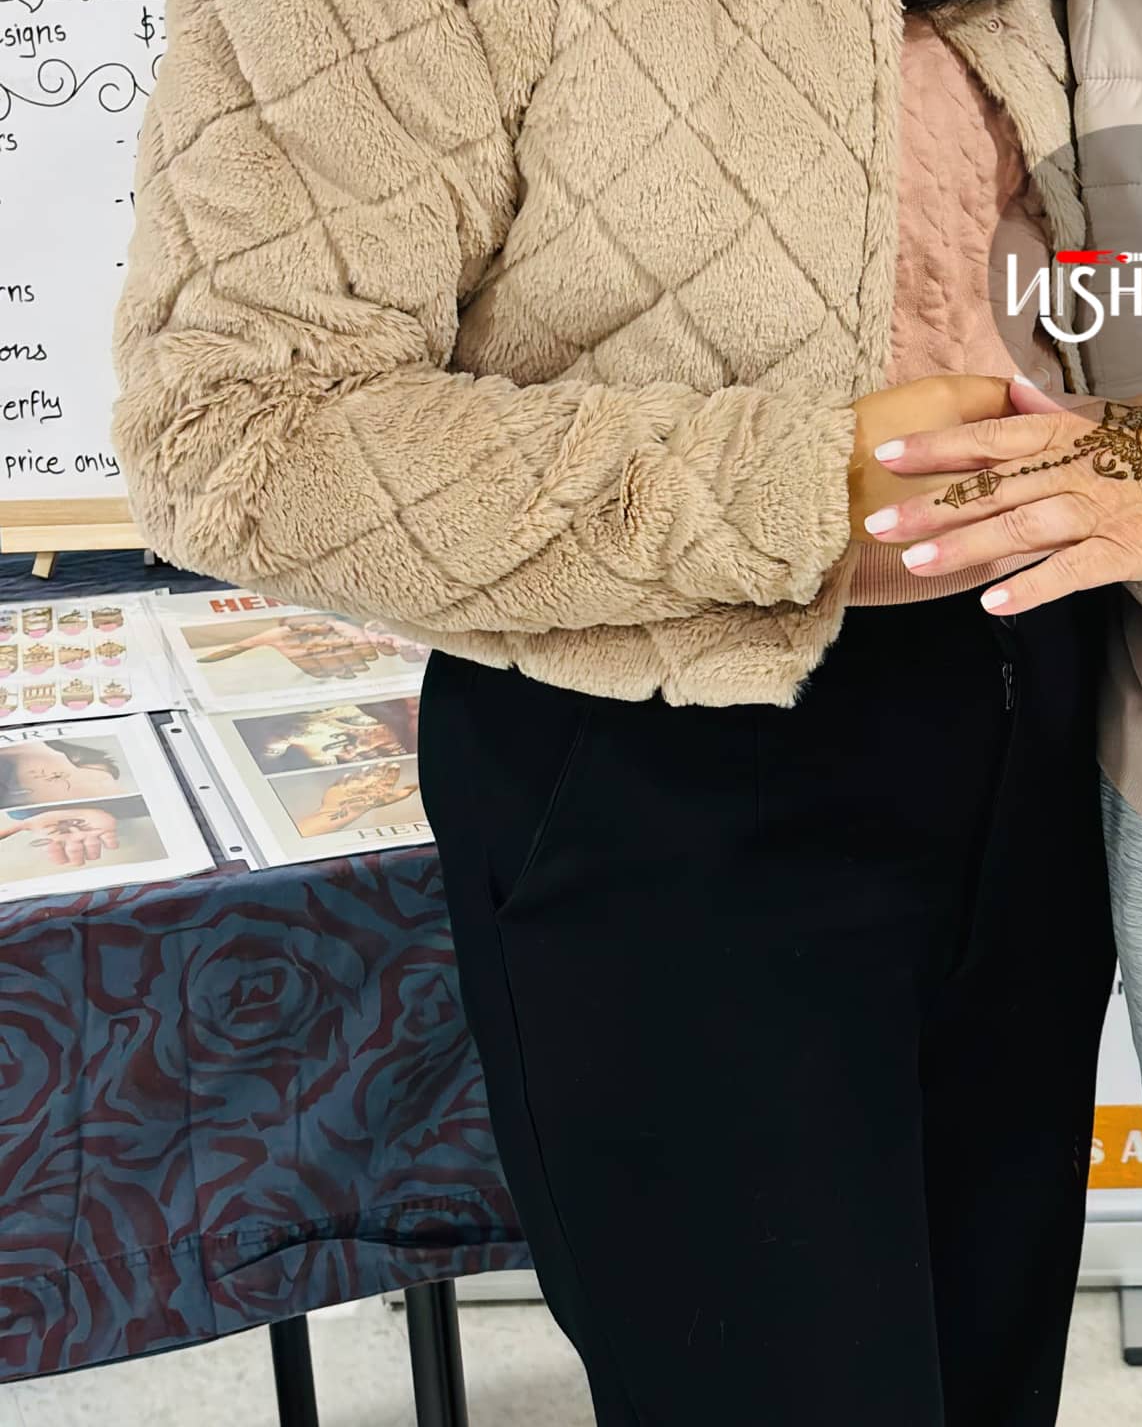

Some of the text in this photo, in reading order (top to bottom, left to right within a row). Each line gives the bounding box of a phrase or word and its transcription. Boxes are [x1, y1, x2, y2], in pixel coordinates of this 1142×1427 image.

[0, 23, 67, 59] signs
[0, 390, 63, 425] erfly
[5, 449, 121, 480] price only
